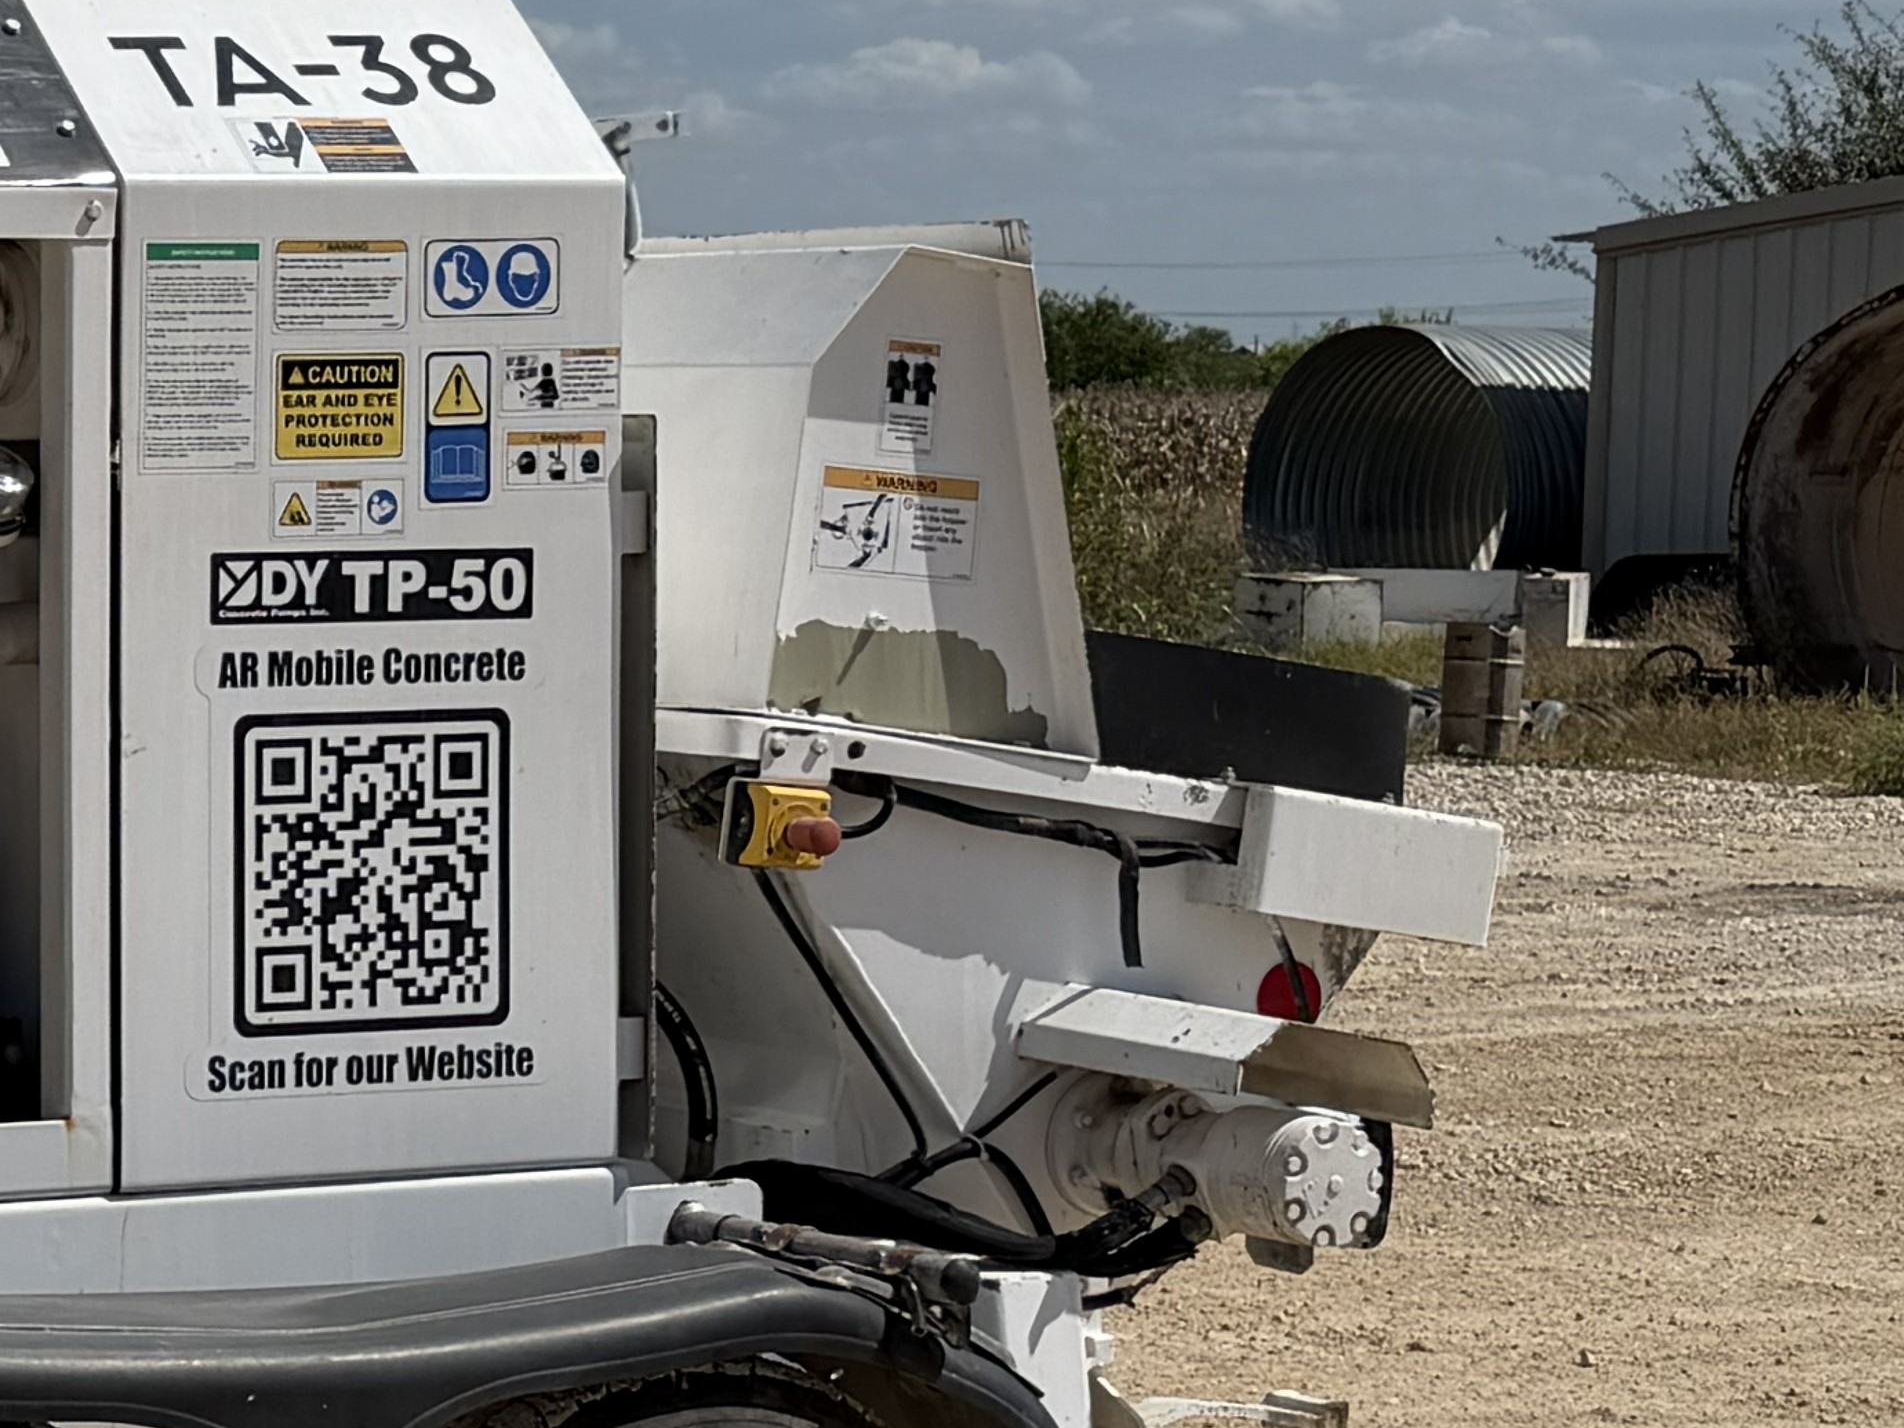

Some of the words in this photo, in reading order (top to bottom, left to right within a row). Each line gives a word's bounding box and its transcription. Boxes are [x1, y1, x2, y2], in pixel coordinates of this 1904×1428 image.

[107, 33, 496, 107] TA-38
[308, 364, 394, 384] CAUTION
[282, 394, 317, 409] EAR
[322, 394, 359, 408] AND
[363, 392, 398, 408] EYE
[284, 412, 395, 429] PROTECTION
[295, 432, 384, 448] REQUIRED
[261, 559, 330, 607] DY
[341, 557, 527, 614] TP-50
[217, 651, 259, 689] AR
[267, 648, 375, 687] Mobile
[382, 647, 526, 685] Concrete
[207, 1055, 286, 1093] Scan
[293, 1052, 339, 1088] for
[345, 1053, 399, 1086] our
[405, 1041, 534, 1082] Website
